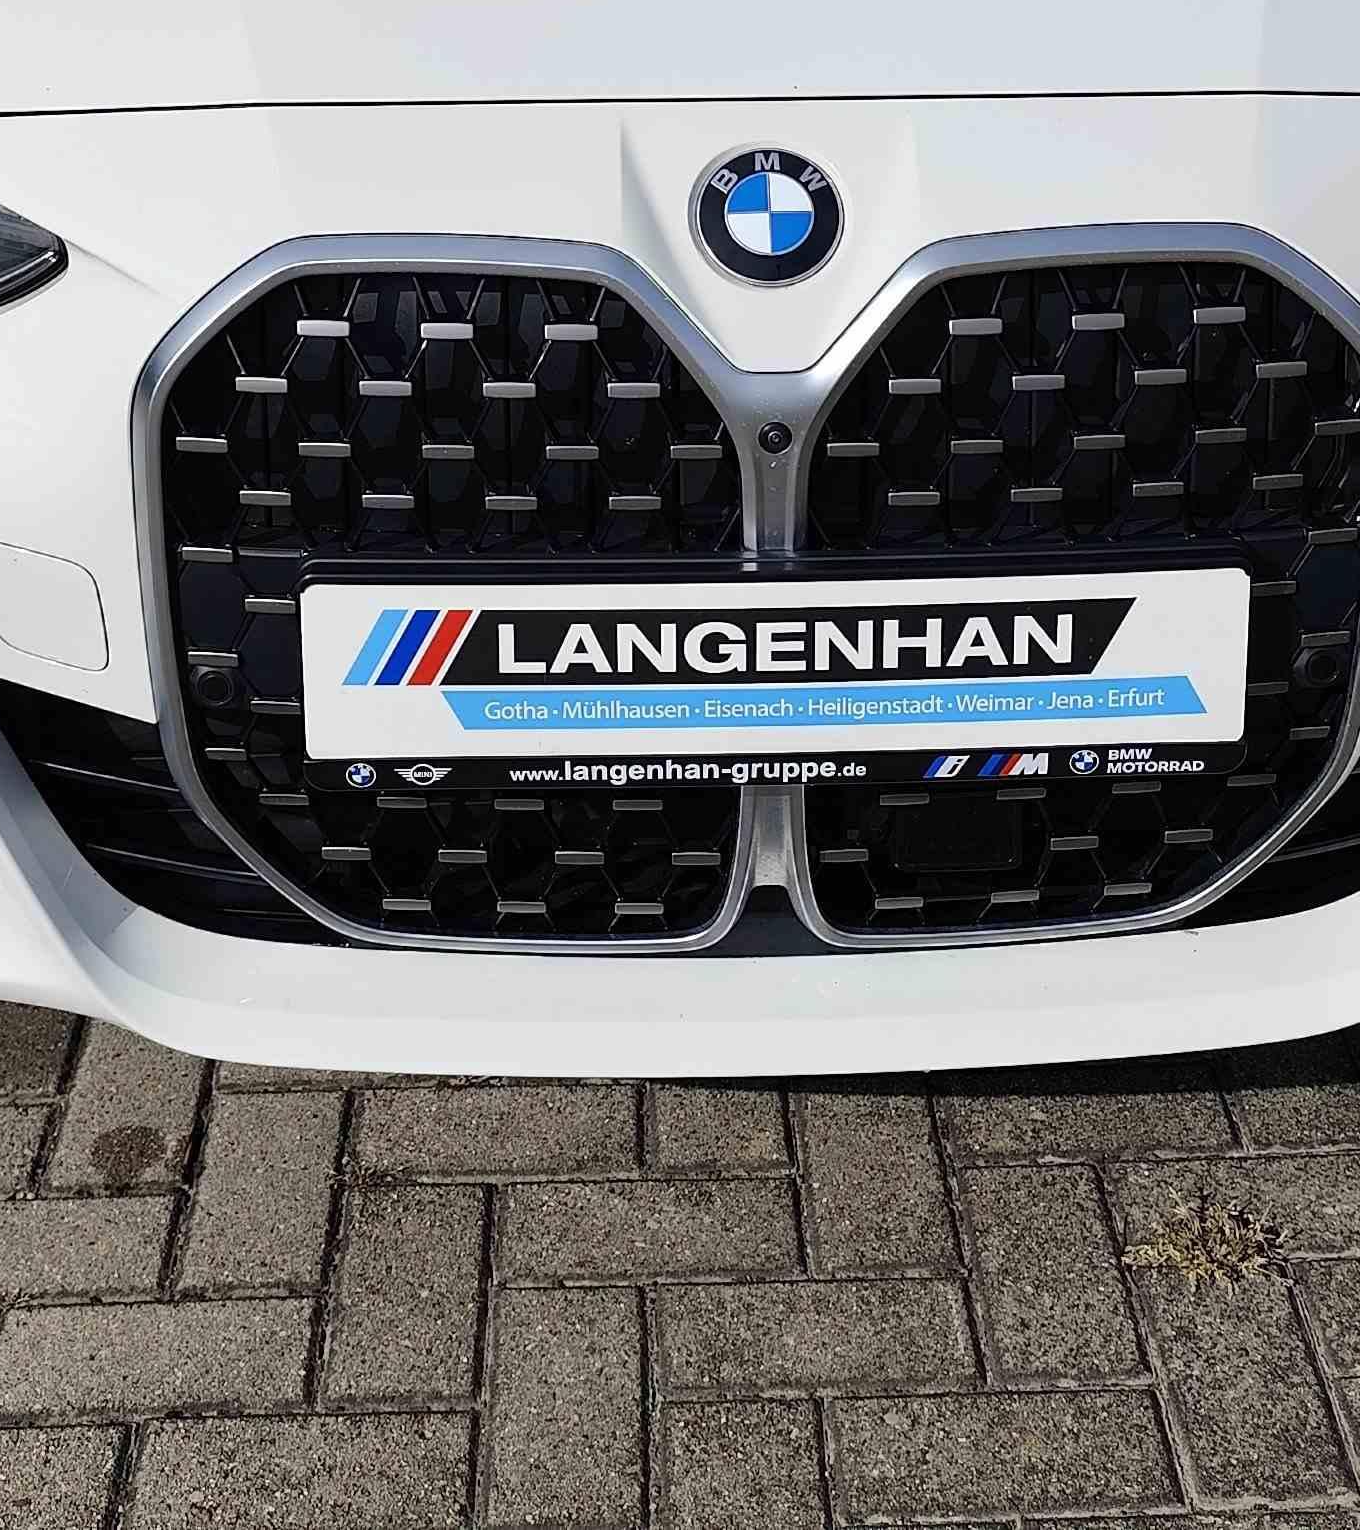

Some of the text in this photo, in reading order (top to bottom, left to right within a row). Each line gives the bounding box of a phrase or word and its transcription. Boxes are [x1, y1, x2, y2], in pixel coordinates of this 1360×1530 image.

[710, 152, 828, 194] BMW
[497, 613, 1073, 674] LANGENHAN
[484, 688, 1165, 720] Gotha Mühlhausen Eisenach Heiligenstadt Weimar Jena Erfurt
[1106, 760, 1205, 774] MOTORRAD
[1107, 749, 1152, 761] BMW
[509, 758, 866, 785] www.langenhan-gruppe.de
